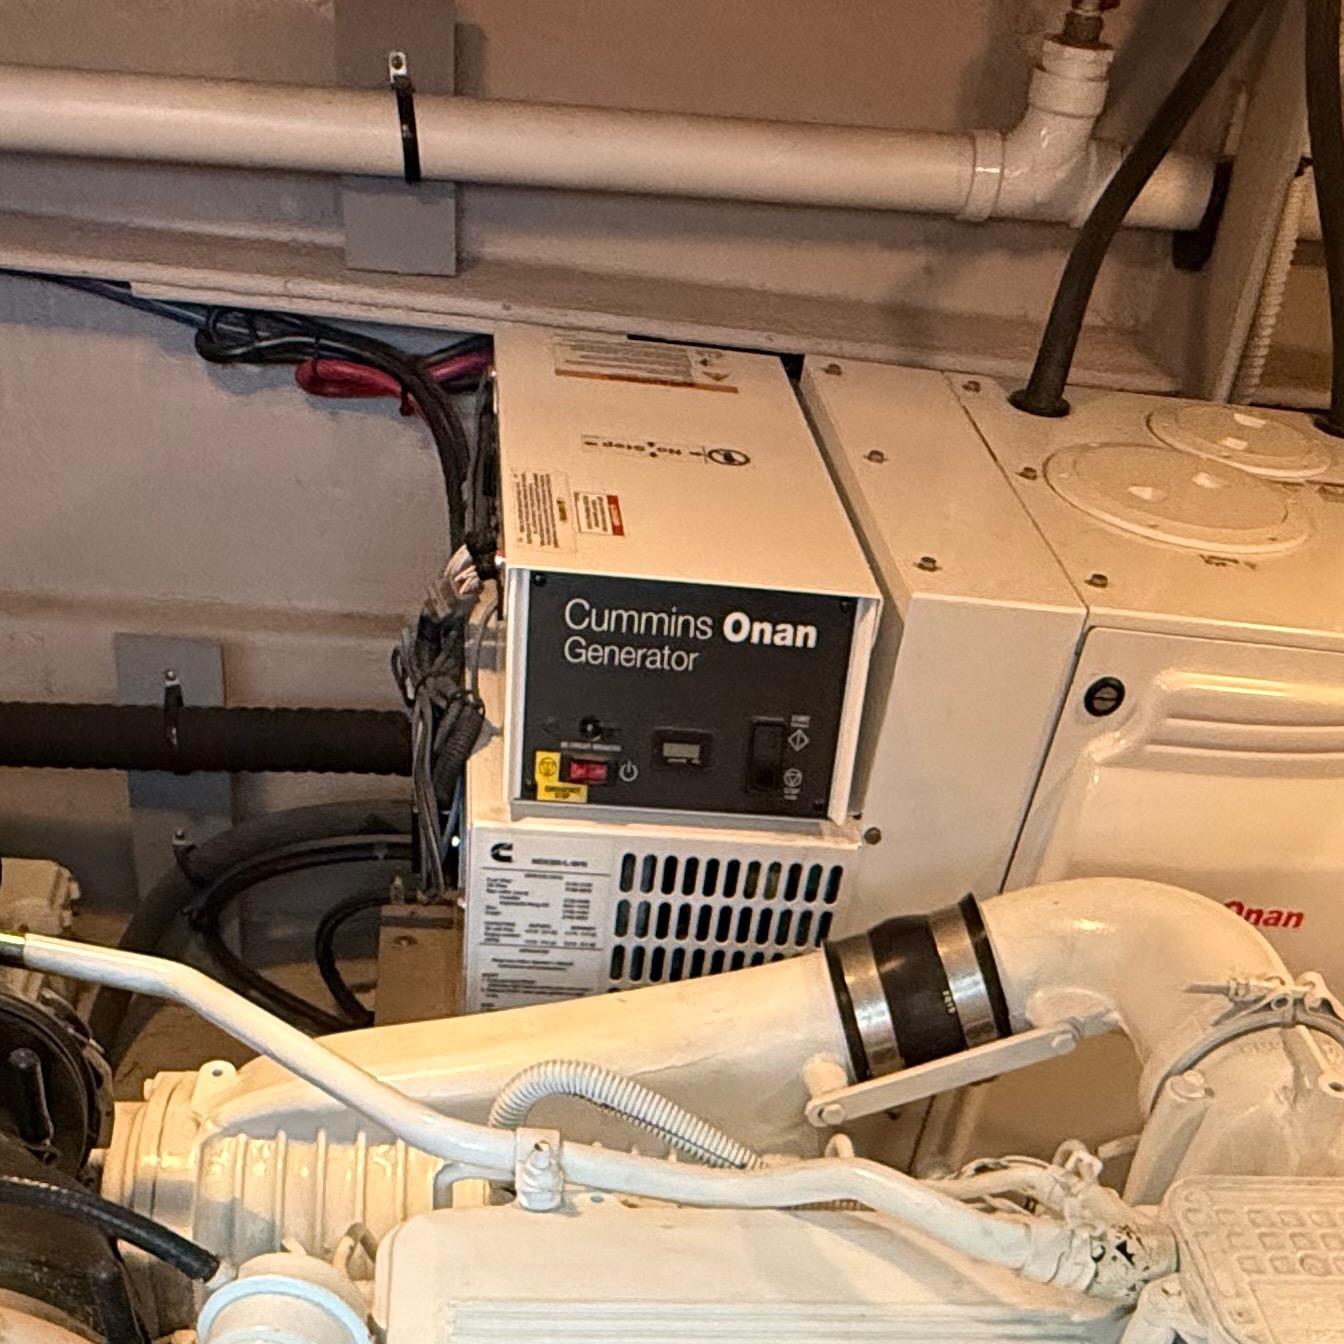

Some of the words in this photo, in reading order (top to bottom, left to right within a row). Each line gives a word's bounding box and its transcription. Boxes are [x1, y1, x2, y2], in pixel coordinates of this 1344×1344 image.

[564, 598, 713, 640] Cummins
[722, 611, 818, 649] Onan
[563, 636, 700, 672] Generator
